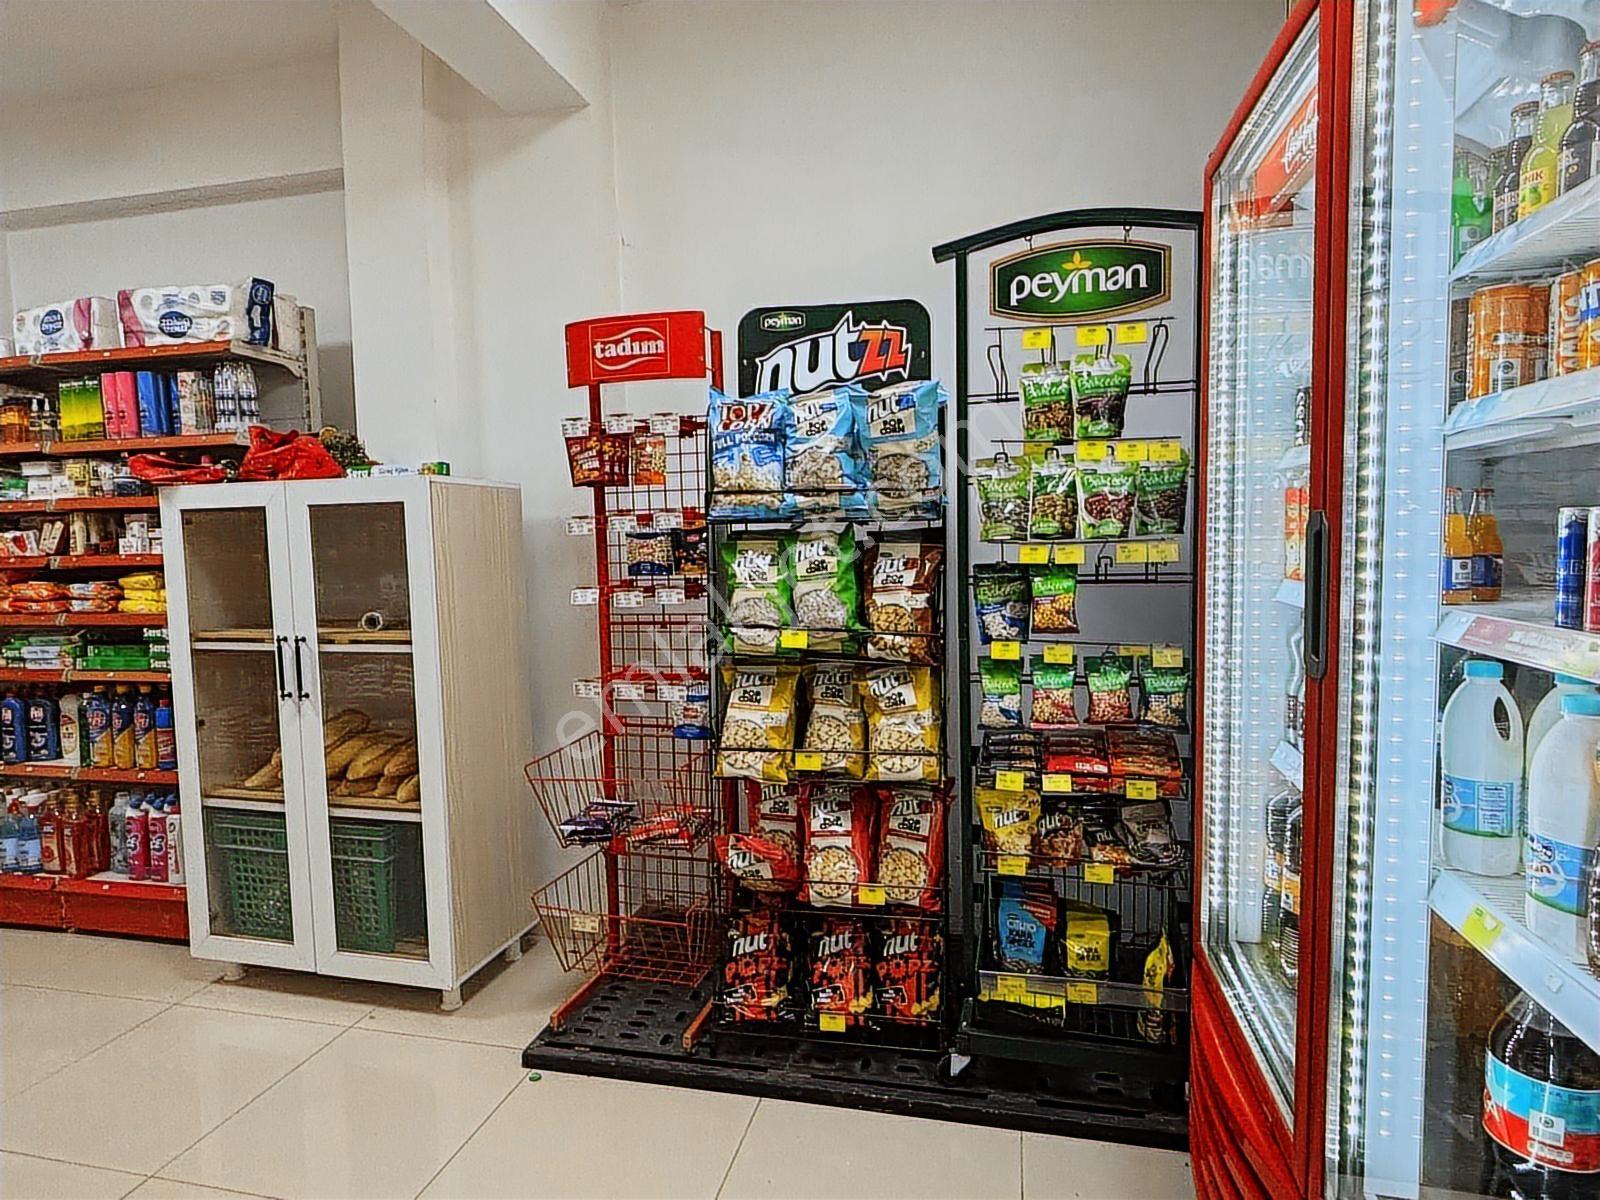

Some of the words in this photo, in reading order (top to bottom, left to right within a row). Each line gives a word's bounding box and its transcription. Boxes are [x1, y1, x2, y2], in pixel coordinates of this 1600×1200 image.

[1010, 262, 1149, 306] peyman
[763, 313, 804, 328] peyman
[882, 418, 903, 427] POP
[880, 424, 905, 435] CORN
